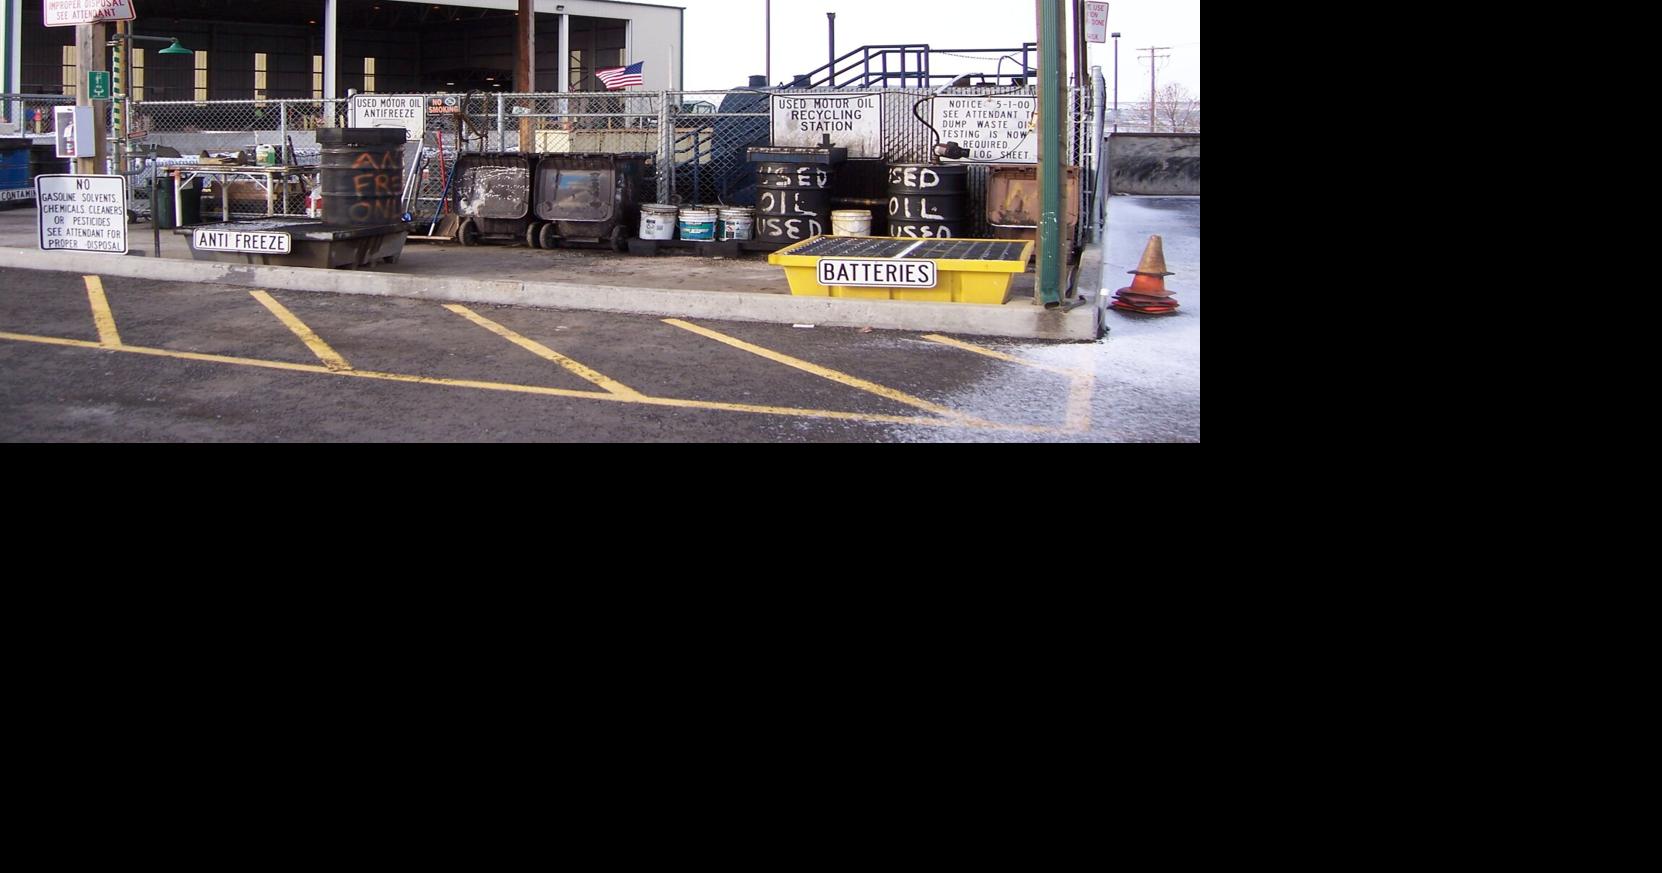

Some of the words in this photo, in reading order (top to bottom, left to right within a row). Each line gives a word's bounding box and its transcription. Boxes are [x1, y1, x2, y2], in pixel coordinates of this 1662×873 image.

[48, 1, 81, 10] IMPROPER
[84, 0, 125, 8] DISPOSAL
[57, 11, 68, 20] SEE
[73, 8, 116, 19] ATTENDANT
[357, 98, 377, 108] USED
[380, 98, 406, 108] MOTOR
[409, 98, 421, 108] OIL
[432, 98, 442, 106] NO
[779, 99, 807, 109] USED
[813, 98, 849, 109] MOTOR
[857, 98, 874, 109] OIL
[949, 100, 982, 109] NOTICE
[996, 100, 1030, 109] 5-1-00
[364, 108, 415, 118] ANTIFREEZE
[428, 105, 459, 114] SMOKING
[791, 109, 862, 121] RECYCLING
[942, 110, 959, 119] SEE
[965, 110, 1018, 119] ATTENDANT
[800, 121, 853, 131] STATION
[942, 120, 967, 128] DUMP
[976, 120, 1008, 129] WASTE
[1017, 121, 1028, 129] OI
[942, 130, 980, 138] TESTING
[1006, 131, 1027, 139] NOW
[963, 141, 1008, 149] REQUIRED
[973, 151, 992, 159] LOG
[1001, 151, 1029, 159] SHEET
[76, 178, 90, 191] NO
[42, 192, 76, 202] GASOLINE
[761, 190, 818, 216] OIL
[889, 196, 945, 220] OIL
[43, 204, 85, 214] CHEMICALS
[88, 205, 123, 216] CLEANERS
[54, 215, 65, 225] OR
[73, 216, 111, 227] PESTICIDES
[47, 227, 63, 237] SEE
[66, 228, 104, 238] ATTENDANT
[107, 229, 121, 239] FOR
[756, 217, 823, 239] USED
[890, 224, 952, 239] USED
[48, 238, 78, 248] PROPER
[86, 240, 121, 251] DISPOSAL
[199, 232, 229, 248] ANTI
[235, 234, 286, 250] FREEZE
[823, 262, 930, 283] BATTERIES
